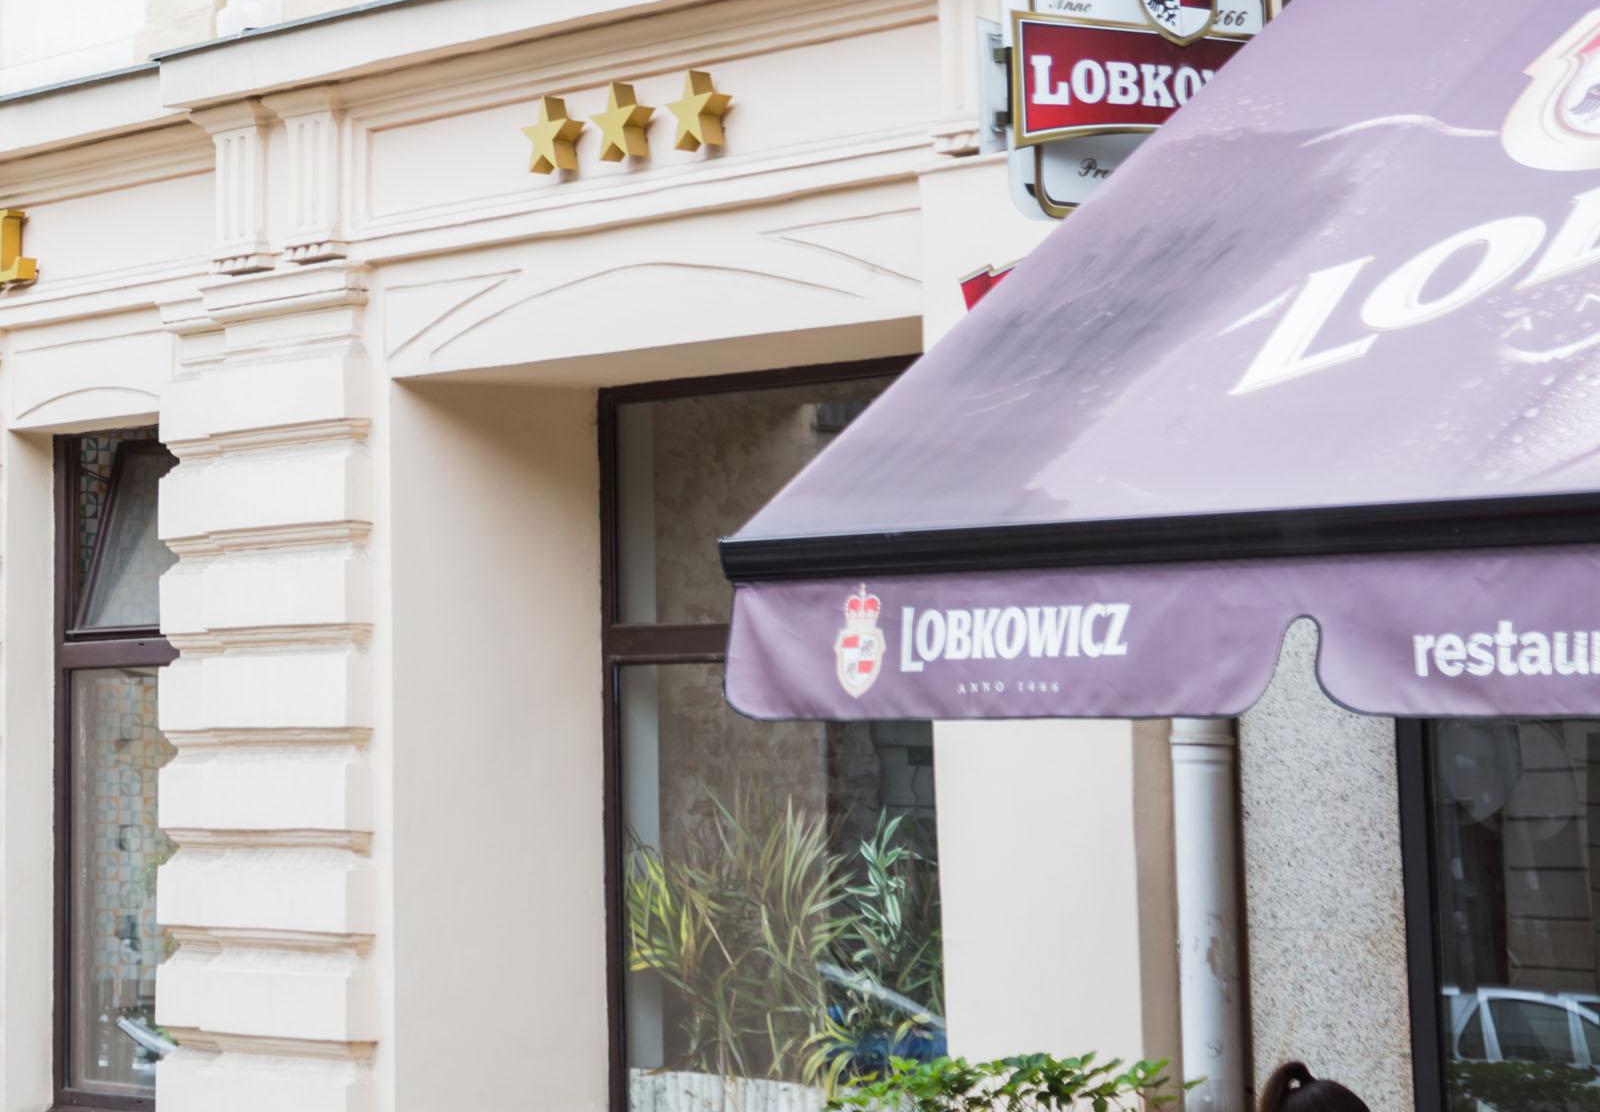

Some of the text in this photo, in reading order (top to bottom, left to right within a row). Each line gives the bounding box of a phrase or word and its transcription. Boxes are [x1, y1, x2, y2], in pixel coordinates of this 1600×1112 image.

[1030, 54, 1216, 109] LOBKO
[1078, 157, 1114, 180] Pre
[900, 603, 1131, 672] LOBKOWICZ
[958, 679, 1005, 695] ANNO
